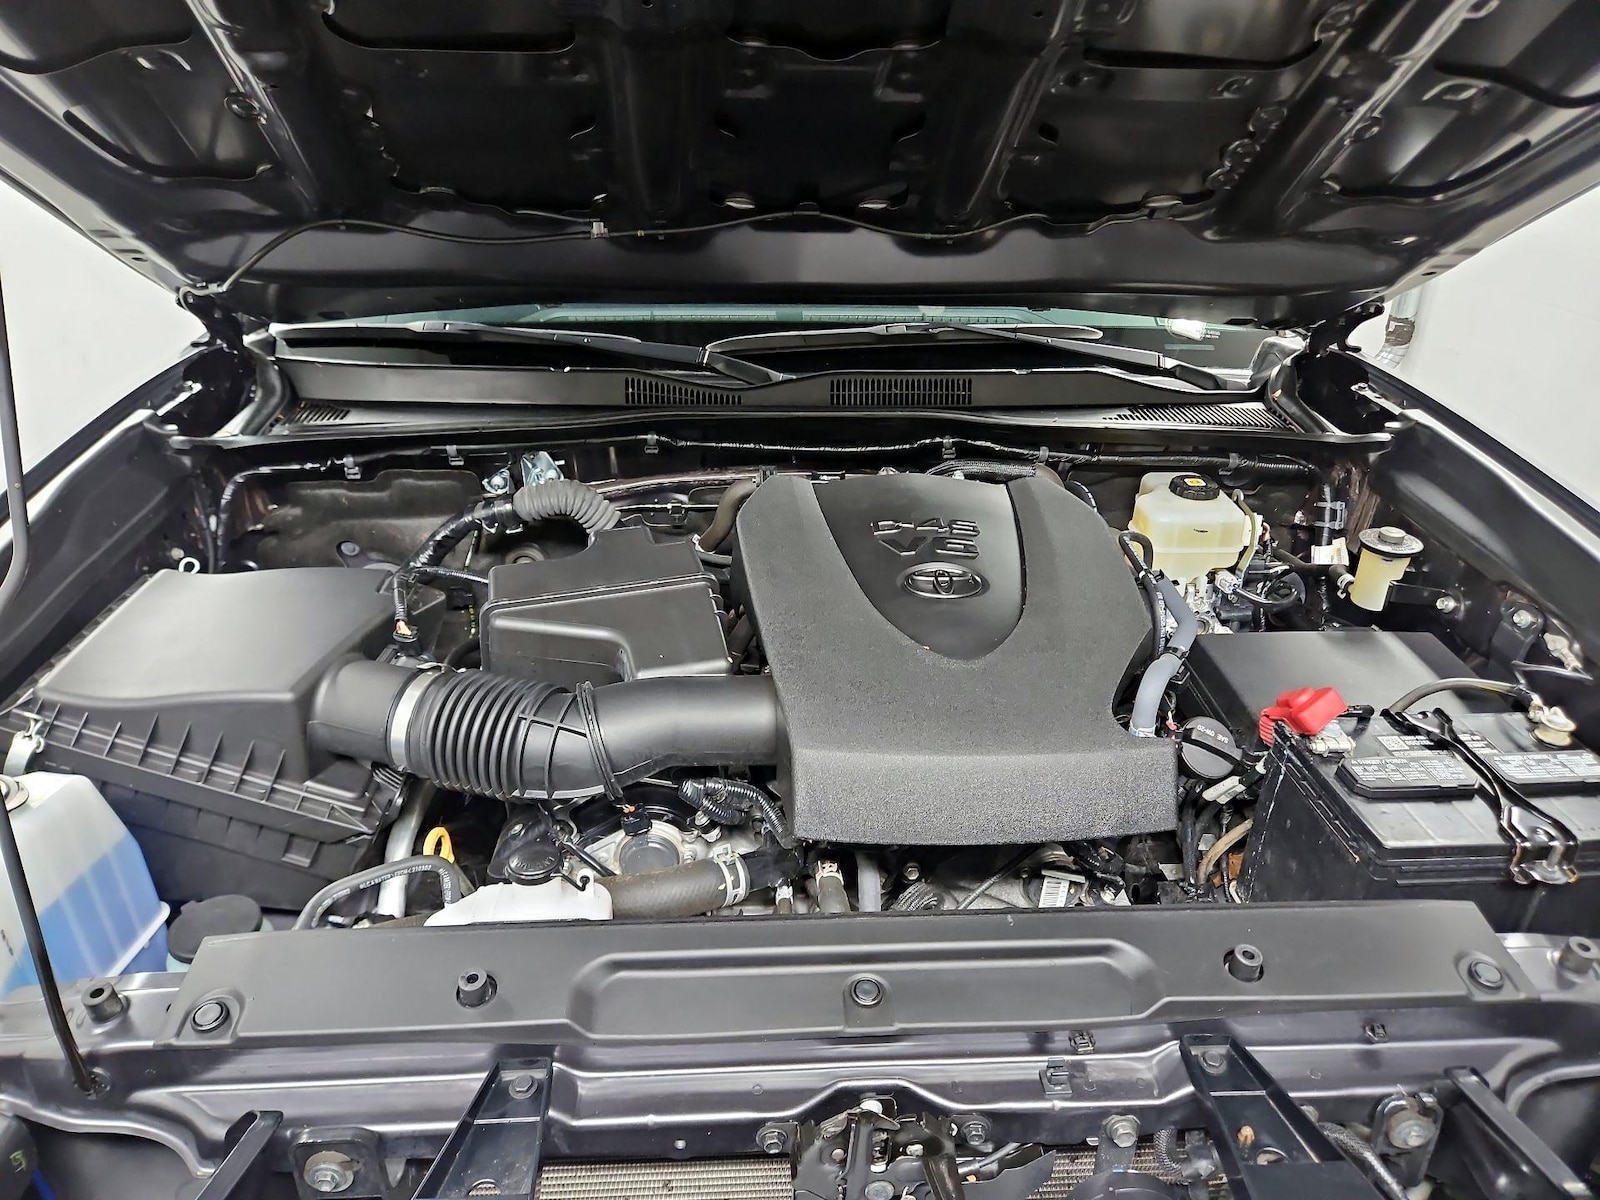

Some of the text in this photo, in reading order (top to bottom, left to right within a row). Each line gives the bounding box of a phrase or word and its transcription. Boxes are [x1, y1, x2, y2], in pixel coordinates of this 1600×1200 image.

[877, 536, 980, 560] V6
[1197, 724, 1230, 744] SAE 0W-20
